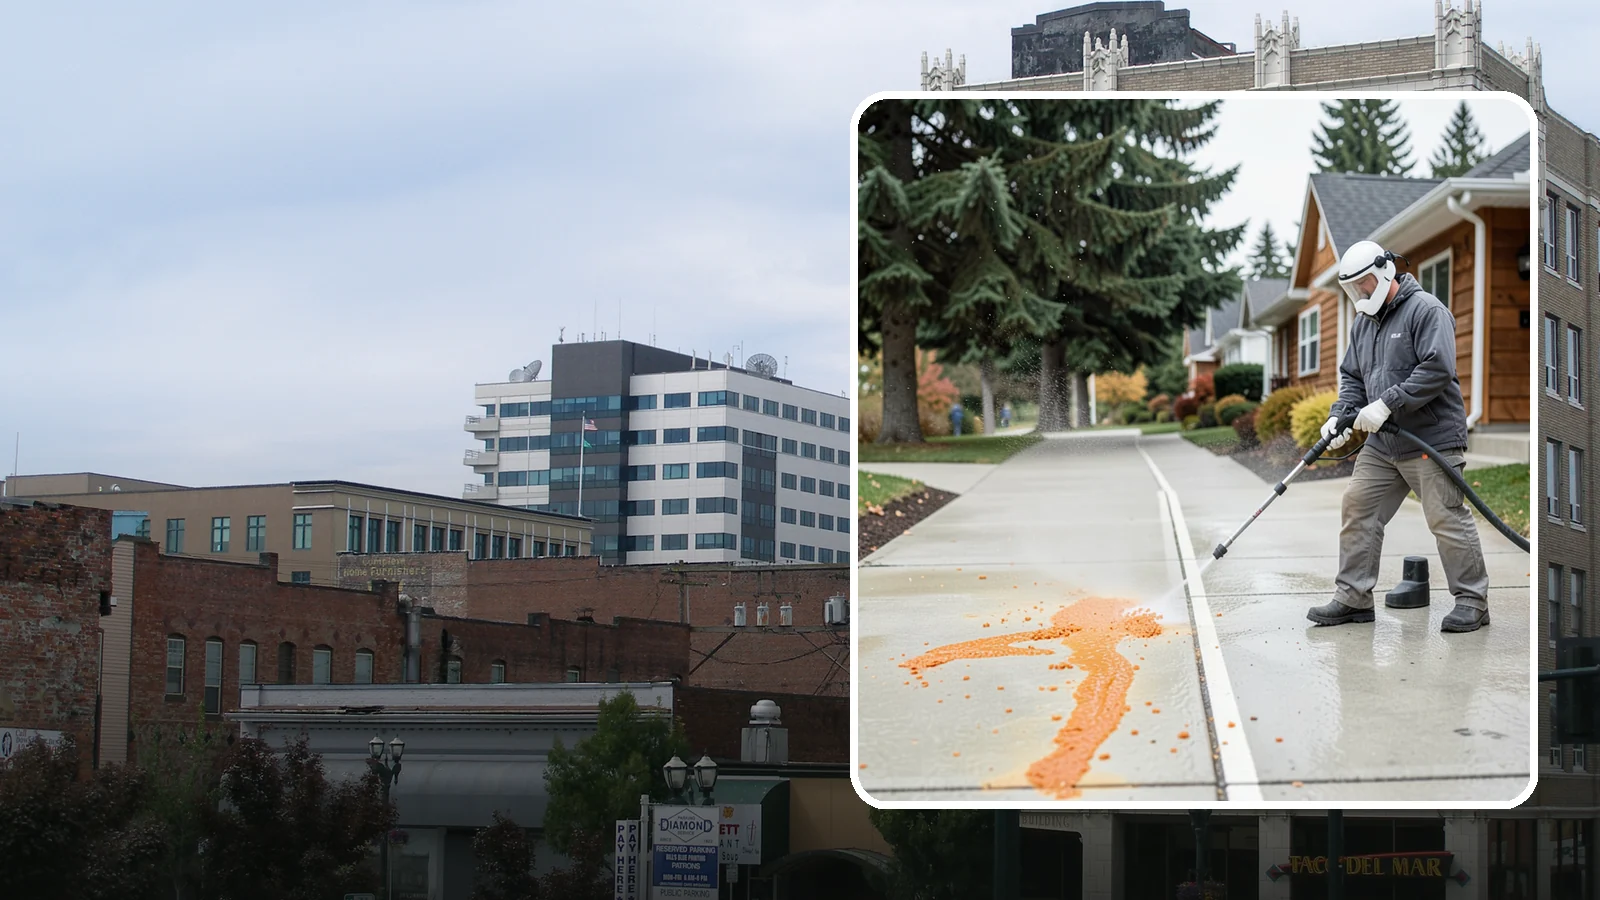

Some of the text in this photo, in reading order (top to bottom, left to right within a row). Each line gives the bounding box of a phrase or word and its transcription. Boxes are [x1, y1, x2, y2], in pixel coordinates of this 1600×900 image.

[343, 566, 427, 577] Home Furnishers
[660, 818, 713, 833] DIAMOND
[1022, 815, 1069, 828] BUILDING
[656, 845, 716, 854] RESERVED PARKING
[617, 825, 625, 893] PAY HERE
[628, 824, 636, 893] PAY HERE
[721, 851, 739, 862] Soup
[671, 862, 701, 870] PATRONS
[1288, 855, 1442, 877] TAC DEL MAR
[660, 888, 710, 898] PUBLIC PARKING
